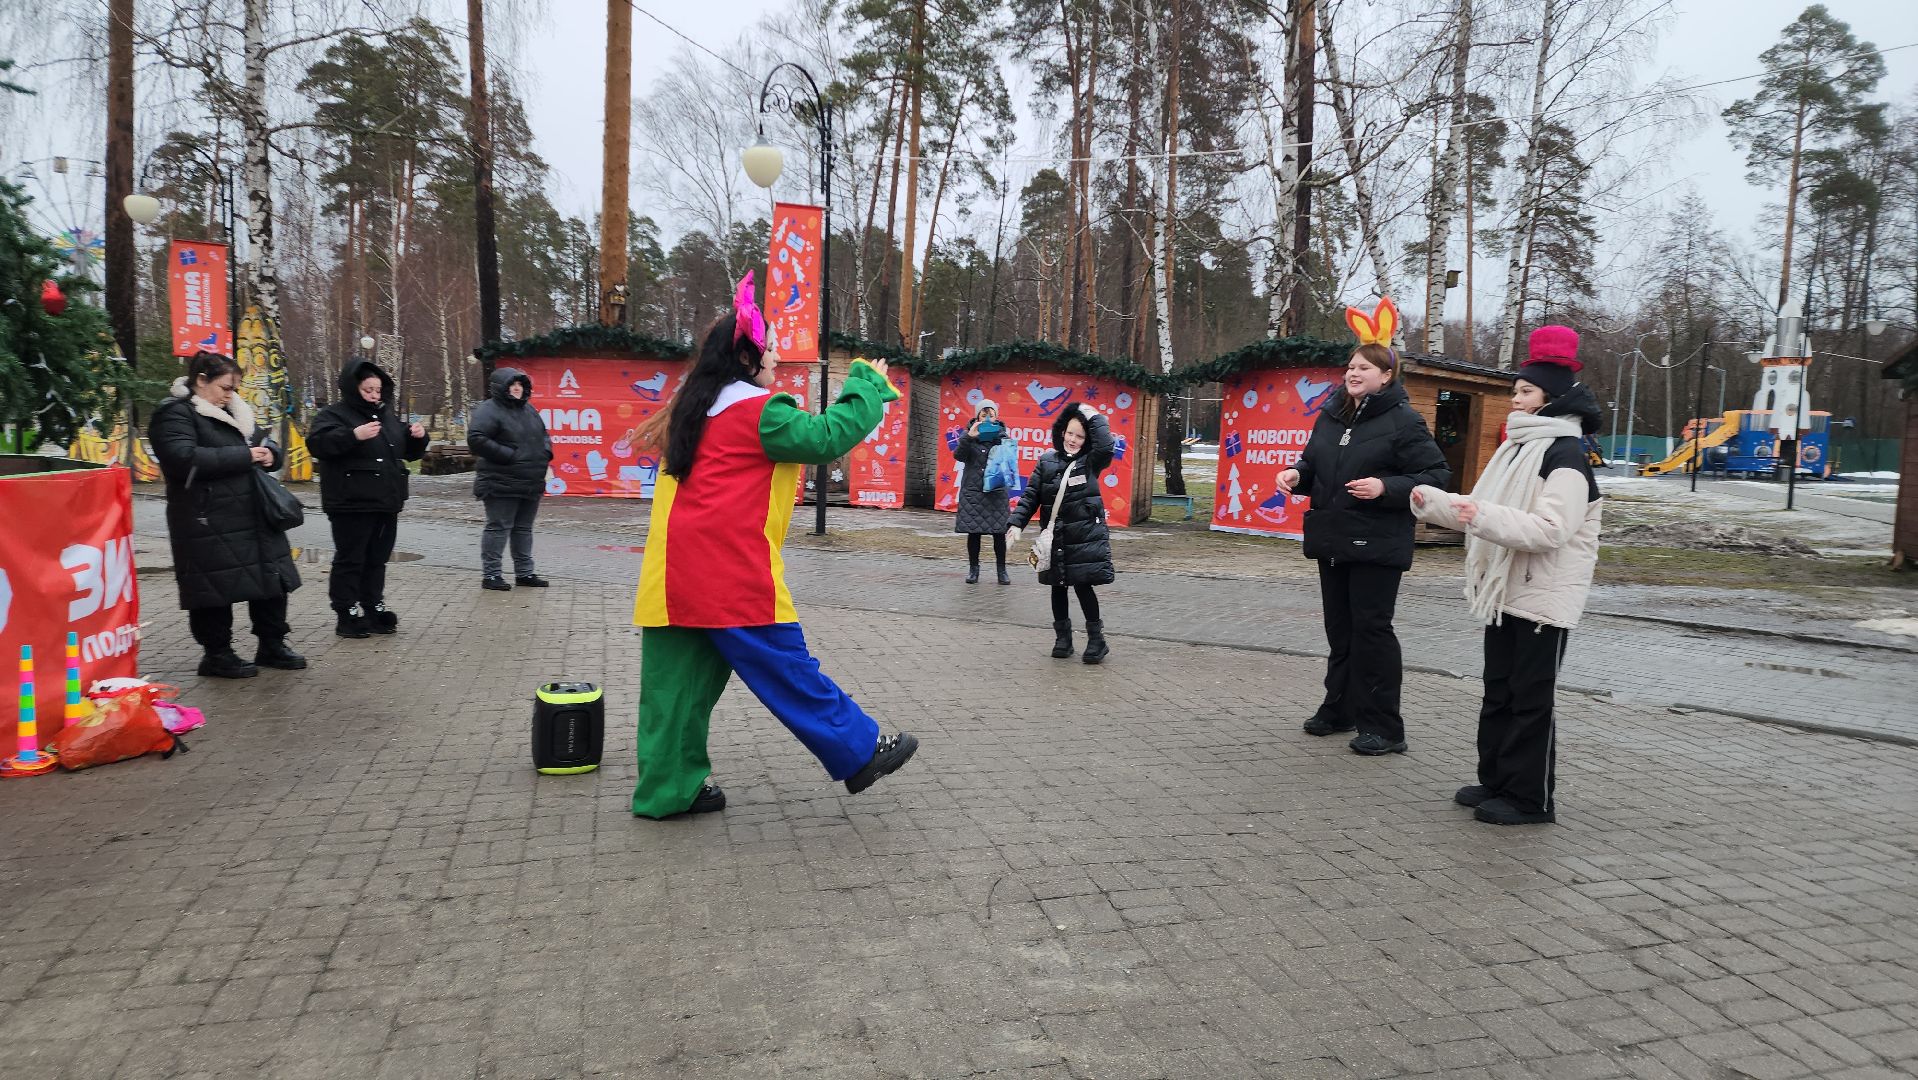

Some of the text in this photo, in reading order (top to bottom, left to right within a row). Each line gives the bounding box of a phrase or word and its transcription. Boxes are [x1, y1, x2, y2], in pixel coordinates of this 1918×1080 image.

[184, 271, 203, 326] ЗИМА
[536, 408, 602, 431] ИМА
[550, 435, 603, 445] ОСКОВЬЕ
[857, 490, 897, 503] ЗИМА
[60, 534, 135, 622] ЗИ
